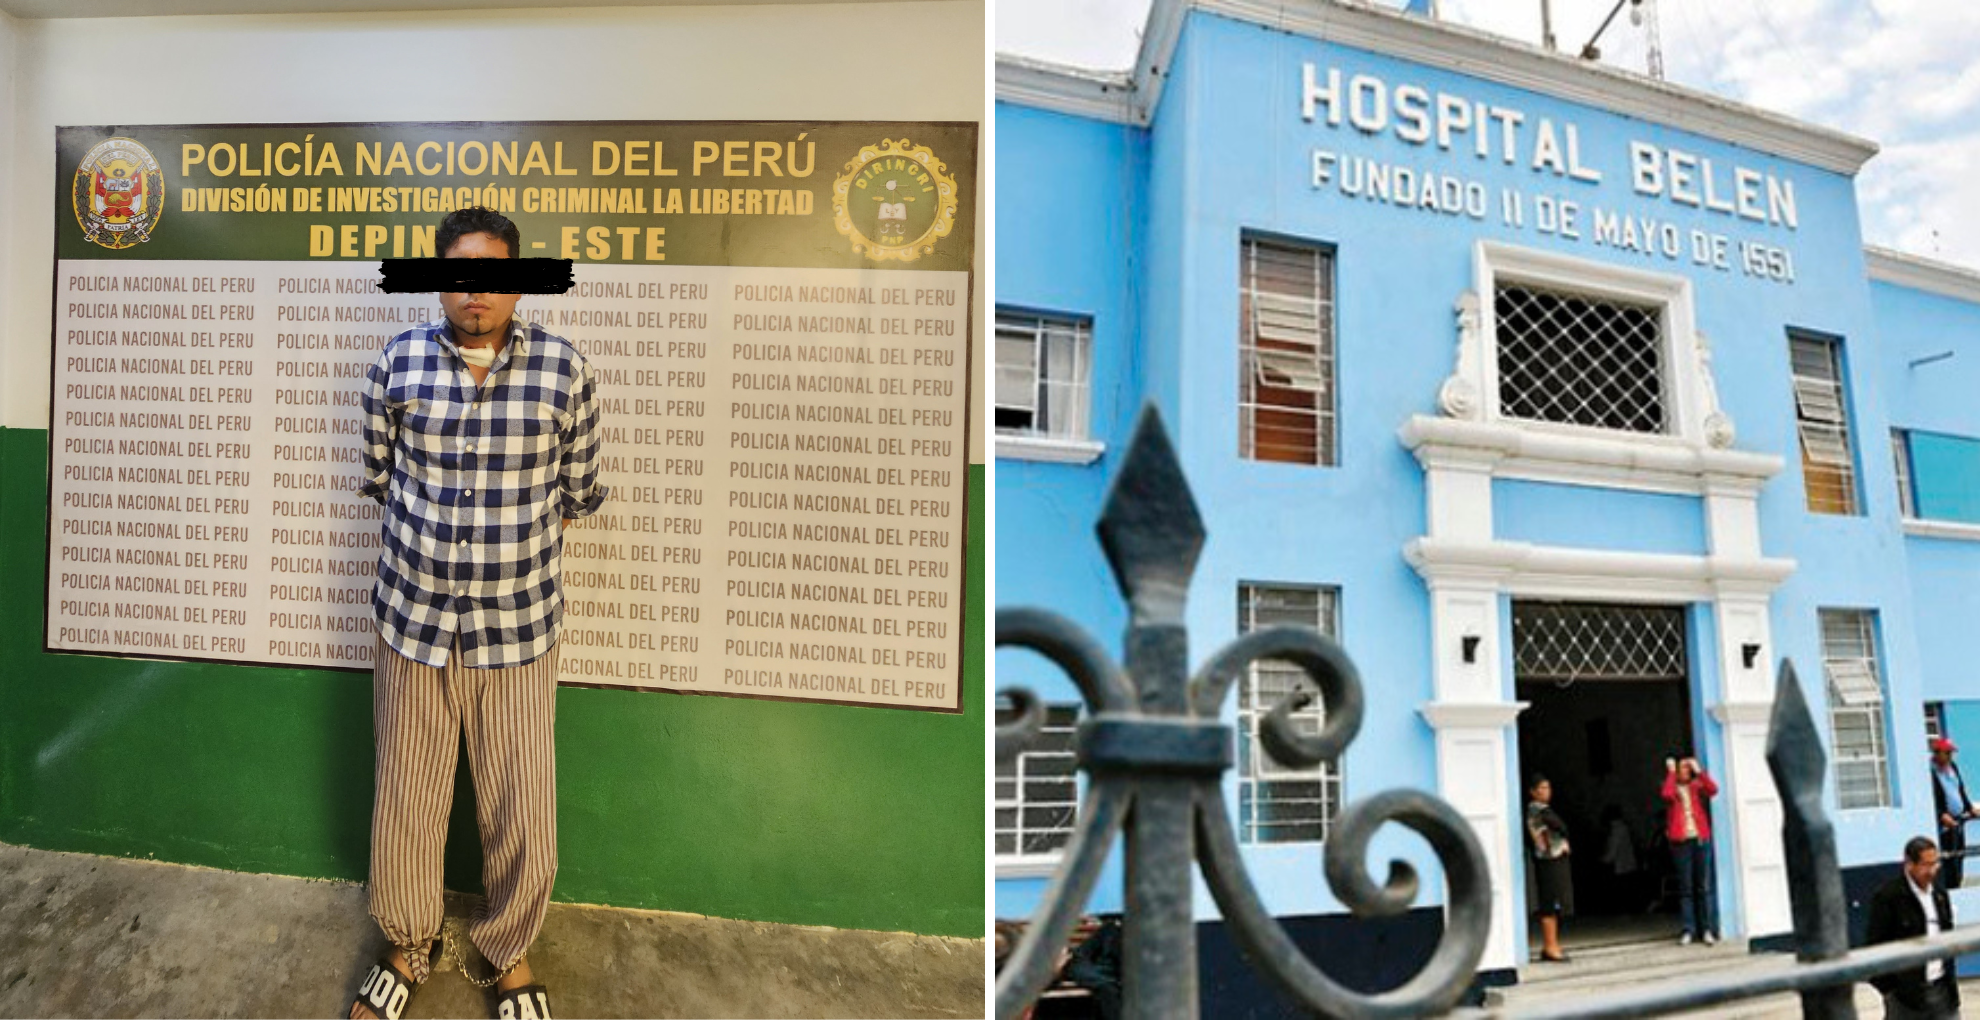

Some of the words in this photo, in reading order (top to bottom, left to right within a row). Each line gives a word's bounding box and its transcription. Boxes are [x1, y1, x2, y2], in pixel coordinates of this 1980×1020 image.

[182, 134, 344, 177] POLICÍA
[355, 140, 578, 177] NACIONAL
[592, 140, 678, 177] DEL
[693, 132, 816, 178] PERÚ
[1302, 62, 1601, 182] HOSPITAL
[1628, 139, 1799, 229] BELEN
[855, 158, 934, 190] DIRINCRI
[181, 183, 287, 212] DIVISIÓN
[292, 187, 322, 212] DE
[327, 182, 516, 213] INVESTIGACIÓN
[522, 186, 648, 213] CRIMINAL
[653, 188, 684, 214] LA
[689, 188, 814, 216] LIBERTAD
[885, 208, 901, 216] LEY
[1312, 148, 1486, 218] FUNDADO
[1537, 195, 1580, 238] DE
[1593, 206, 1681, 259] MAYO
[1691, 229, 1730, 269] DE
[1740, 239, 1795, 282] 1551
[310, 224, 436, 258] DEPIN
[560, 225, 666, 261] ESTE
[70, 276, 118, 291] POLICIA
[123, 277, 188, 292] NACIONAL
[193, 277, 216, 292] DEL
[221, 278, 254, 293] PERU
[735, 285, 793, 301] POLICIA
[800, 287, 875, 304] NACIONAL
[882, 289, 909, 305] DEL
[916, 289, 955, 306] PERU
[69, 303, 118, 318] POLICIA
[123, 304, 187, 319] NACIONAL
[192, 305, 215, 320] DEL
[220, 305, 254, 320] PERU
[278, 306, 330, 321] POLICIA
[335, 306, 403, 323] NACIONAL
[408, 307, 433, 323] DEL
[559, 310, 632, 327] NACIONAL
[637, 312, 663, 328] DEL
[669, 313, 706, 329] PERU
[734, 314, 792, 331] POLICIA
[799, 316, 874, 334] NACIONAL
[881, 319, 908, 334] DEL
[915, 319, 954, 336] PERU
[68, 330, 117, 345] POLICIA
[122, 331, 186, 347] NACIONAL
[191, 332, 215, 347] DEL
[220, 333, 253, 348] PERU
[68, 357, 116, 372] POLICIA
[122, 358, 186, 374] NACIONAL
[191, 360, 214, 375] DEL
[219, 360, 252, 376] PERU
[733, 344, 791, 361] POLICIA
[798, 346, 874, 364] NACIONAL
[880, 348, 907, 364] DEL
[914, 349, 953, 366] PERU
[733, 373, 791, 391] POLICIA
[797, 375, 873, 394] NACIONAL
[880, 378, 907, 395] DEL
[913, 379, 953, 396] PERU
[66, 411, 115, 427] POLICIA
[120, 413, 184, 429] NACIONAL
[189, 415, 212, 430] DEL
[217, 415, 251, 431] PERU
[65, 438, 114, 454] POLICIA
[119, 440, 184, 456] NACIONAL
[188, 442, 212, 457] DEL
[217, 443, 250, 459] PERU
[731, 432, 789, 450] POLICIA
[796, 435, 872, 454] NACIONAL
[878, 438, 905, 455] DEL
[912, 439, 951, 457] PERU
[65, 465, 113, 481] POLICIA
[119, 467, 183, 484] NACIONAL
[188, 470, 211, 485] DEL
[216, 471, 249, 487] PERU
[730, 462, 788, 480] POLICIA
[795, 464, 871, 484] NACIONAL
[877, 468, 905, 485] DEL
[911, 470, 950, 487] PERU
[64, 492, 112, 509] POLICIA
[118, 494, 181, 512] NACIONAL
[186, 497, 210, 513] DEL
[215, 498, 248, 514] PERU
[273, 501, 324, 518] POLICIA
[330, 503, 385, 520] NACION
[730, 491, 788, 510] POLICIA
[794, 494, 870, 514] NACIONAL
[877, 498, 904, 515] DEL
[911, 500, 949, 517] PERU
[63, 519, 112, 536] POLICIA
[117, 522, 181, 539] NACIONAL
[186, 525, 210, 540] DEL
[214, 526, 248, 542] PERU
[272, 529, 324, 546] POLICIA
[329, 531, 383, 548] NACION
[729, 521, 787, 539] POLICIA
[793, 524, 870, 544] NACIONAL
[876, 528, 903, 545] DEL
[909, 530, 949, 548] PERU
[62, 546, 111, 563] POLICIA
[116, 549, 181, 566] NACIONAL
[185, 552, 209, 568] DEL
[214, 554, 247, 570] PERU
[564, 542, 626, 560] ACIONAL
[631, 545, 658, 562] DEL
[663, 547, 701, 564] PERU
[728, 550, 786, 569] POLICIA
[792, 554, 869, 574] NACIONAL
[875, 558, 902, 575] DEL
[909, 560, 948, 578] PERU
[563, 571, 625, 589] ACIONAL
[631, 574, 657, 591] DEL
[663, 576, 700, 594] PERU
[727, 580, 785, 599] POLICIA
[792, 584, 868, 604] NACIONAL
[874, 588, 902, 606] DEL
[908, 590, 947, 608] PERU
[61, 600, 110, 617] POLICIA
[115, 603, 179, 621] NACIONAL
[184, 607, 207, 623] DEL
[212, 609, 246, 625] PERU
[60, 627, 109, 644] POLICIA
[114, 630, 178, 648] NACIONAL
[183, 635, 206, 650] DEL
[212, 636, 245, 653] PERU
[269, 640, 321, 658] POLICIA
[327, 644, 376, 661] NACION
[726, 639, 783, 658] POLICIA
[790, 643, 866, 664] NACIONAL
[873, 649, 900, 666] DEL
[906, 651, 945, 669] PERU
[560, 658, 622, 677] ACIONAL
[628, 662, 654, 679] DEL
[660, 664, 697, 682] PERU
[725, 669, 782, 688] POLICIA
[789, 673, 865, 693] NACIONAL
[872, 679, 899, 696] DEL
[905, 681, 945, 699] PERU
